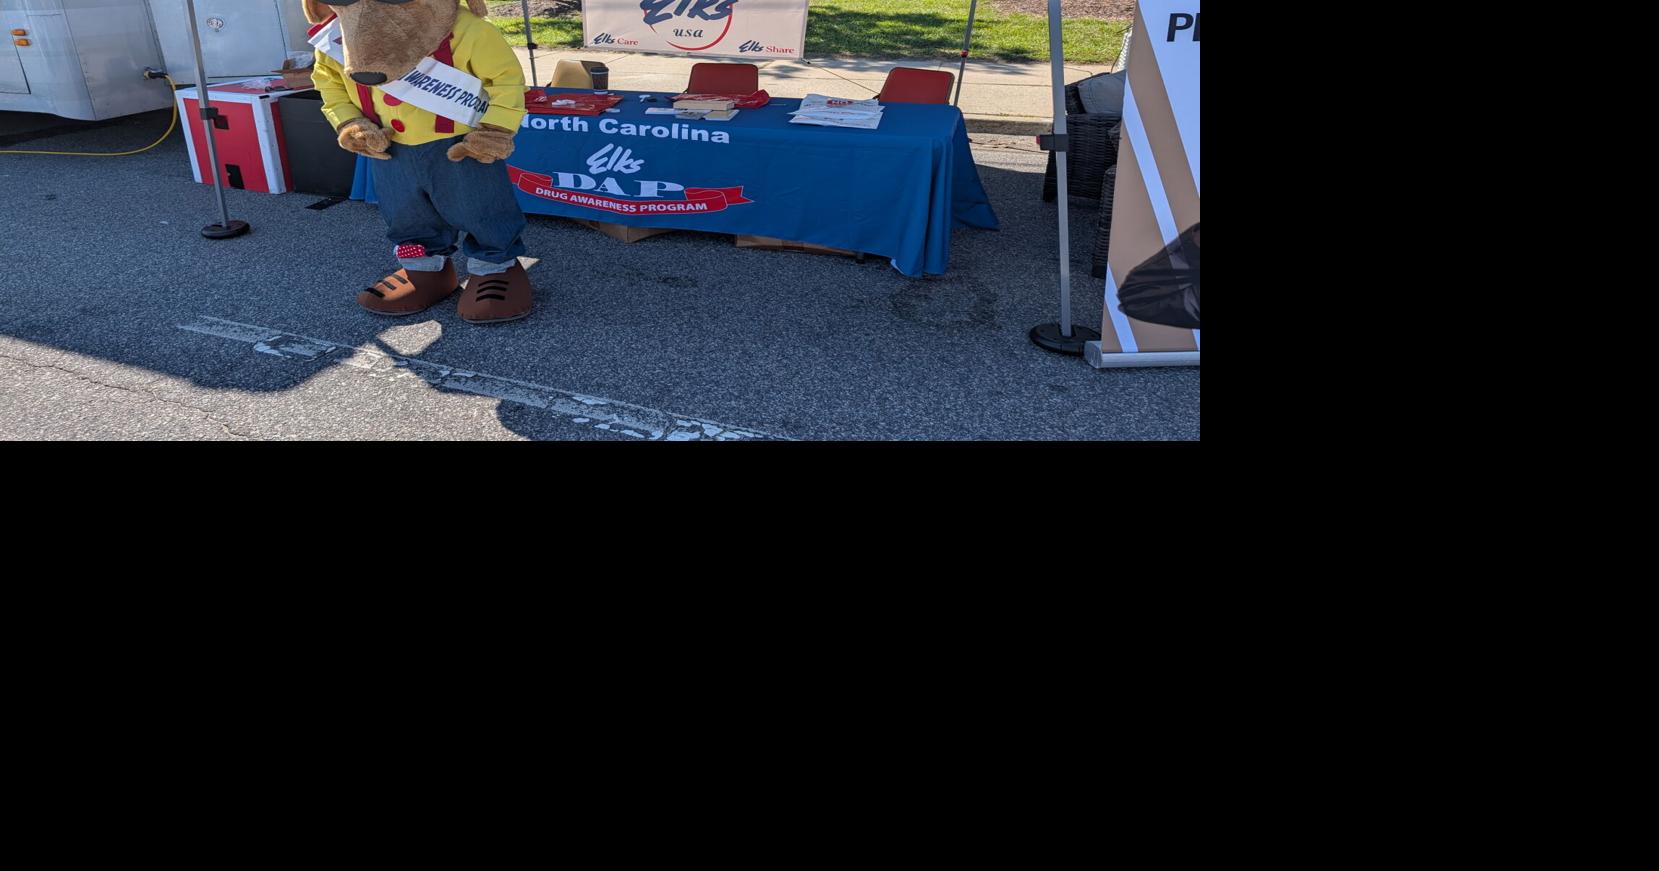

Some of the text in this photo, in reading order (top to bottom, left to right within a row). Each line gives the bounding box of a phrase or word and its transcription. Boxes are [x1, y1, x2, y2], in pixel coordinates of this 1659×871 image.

[593, 32, 639, 46] Elks Care
[673, 28, 703, 38] usa
[738, 39, 795, 54] Elks Share
[400, 68, 461, 101] WARENESS
[599, 118, 730, 144] Carolina
[586, 143, 645, 175] Elks
[535, 187, 708, 213] DRUG AWARENESS PROGRAM
